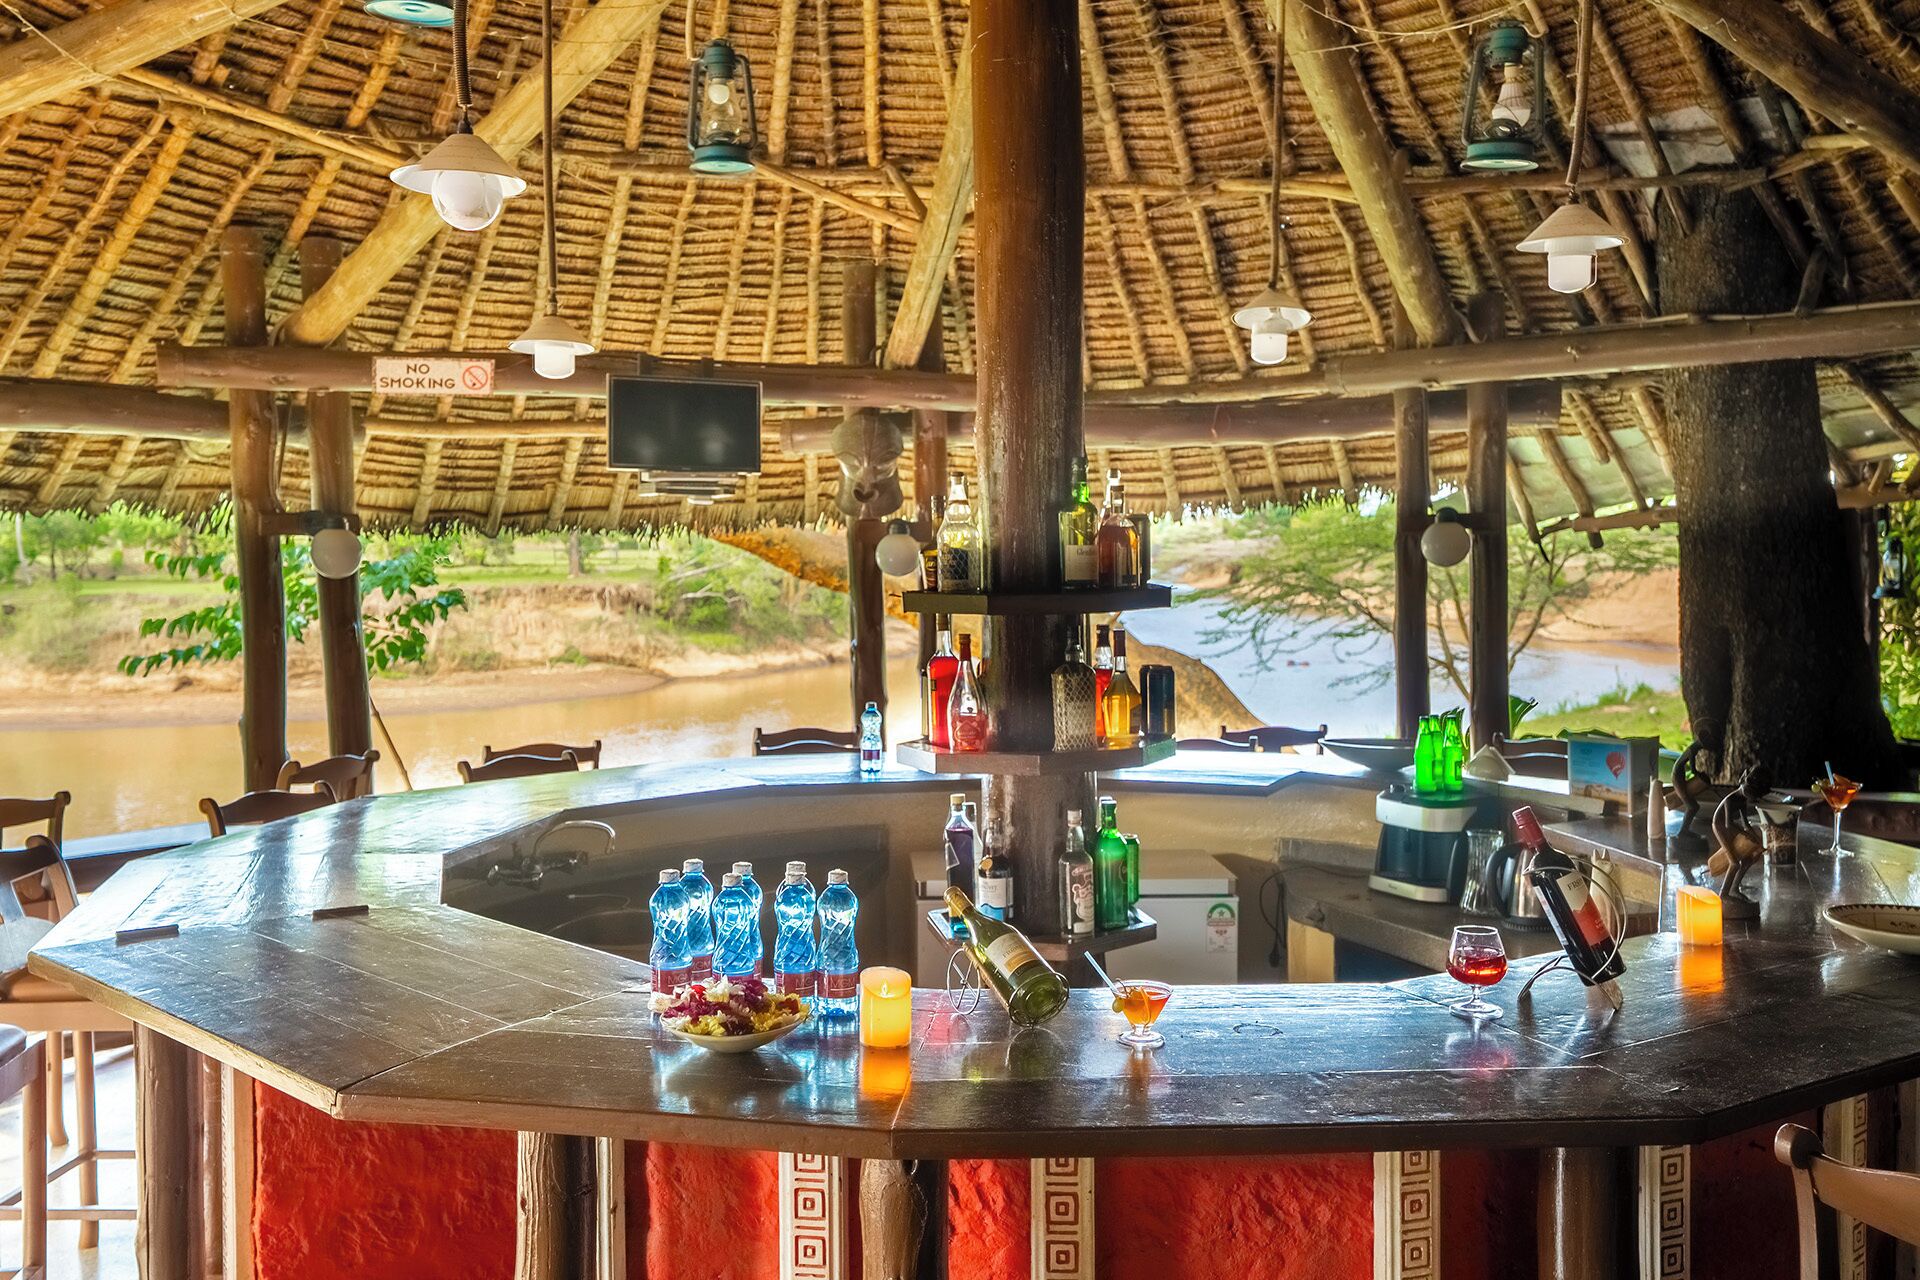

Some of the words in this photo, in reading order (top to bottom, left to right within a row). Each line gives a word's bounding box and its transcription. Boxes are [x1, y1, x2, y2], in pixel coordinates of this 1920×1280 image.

[406, 364, 430, 374] NO
[380, 377, 455, 389] SMOKING
[830, 976, 855, 988] MGM
